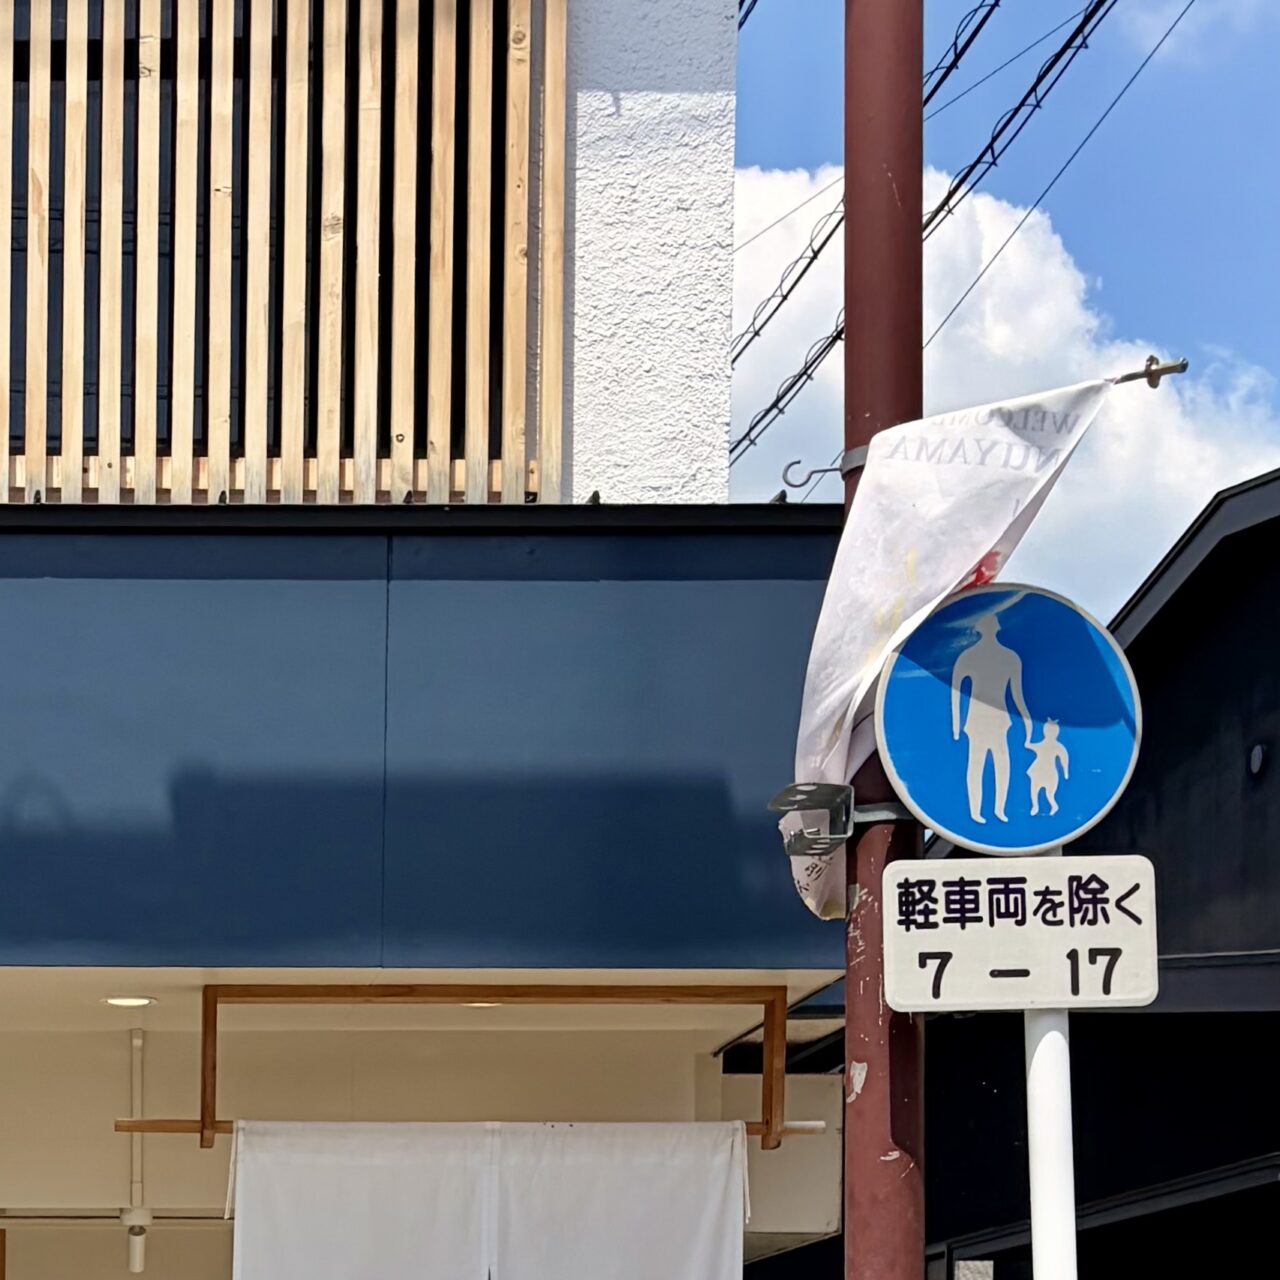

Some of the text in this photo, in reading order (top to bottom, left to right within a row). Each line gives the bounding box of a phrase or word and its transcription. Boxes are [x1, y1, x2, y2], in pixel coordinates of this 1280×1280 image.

[896, 873, 1143, 932] 軽車両を除く
[918, 951, 953, 999] 7
[1066, 947, 1123, 996] 17
